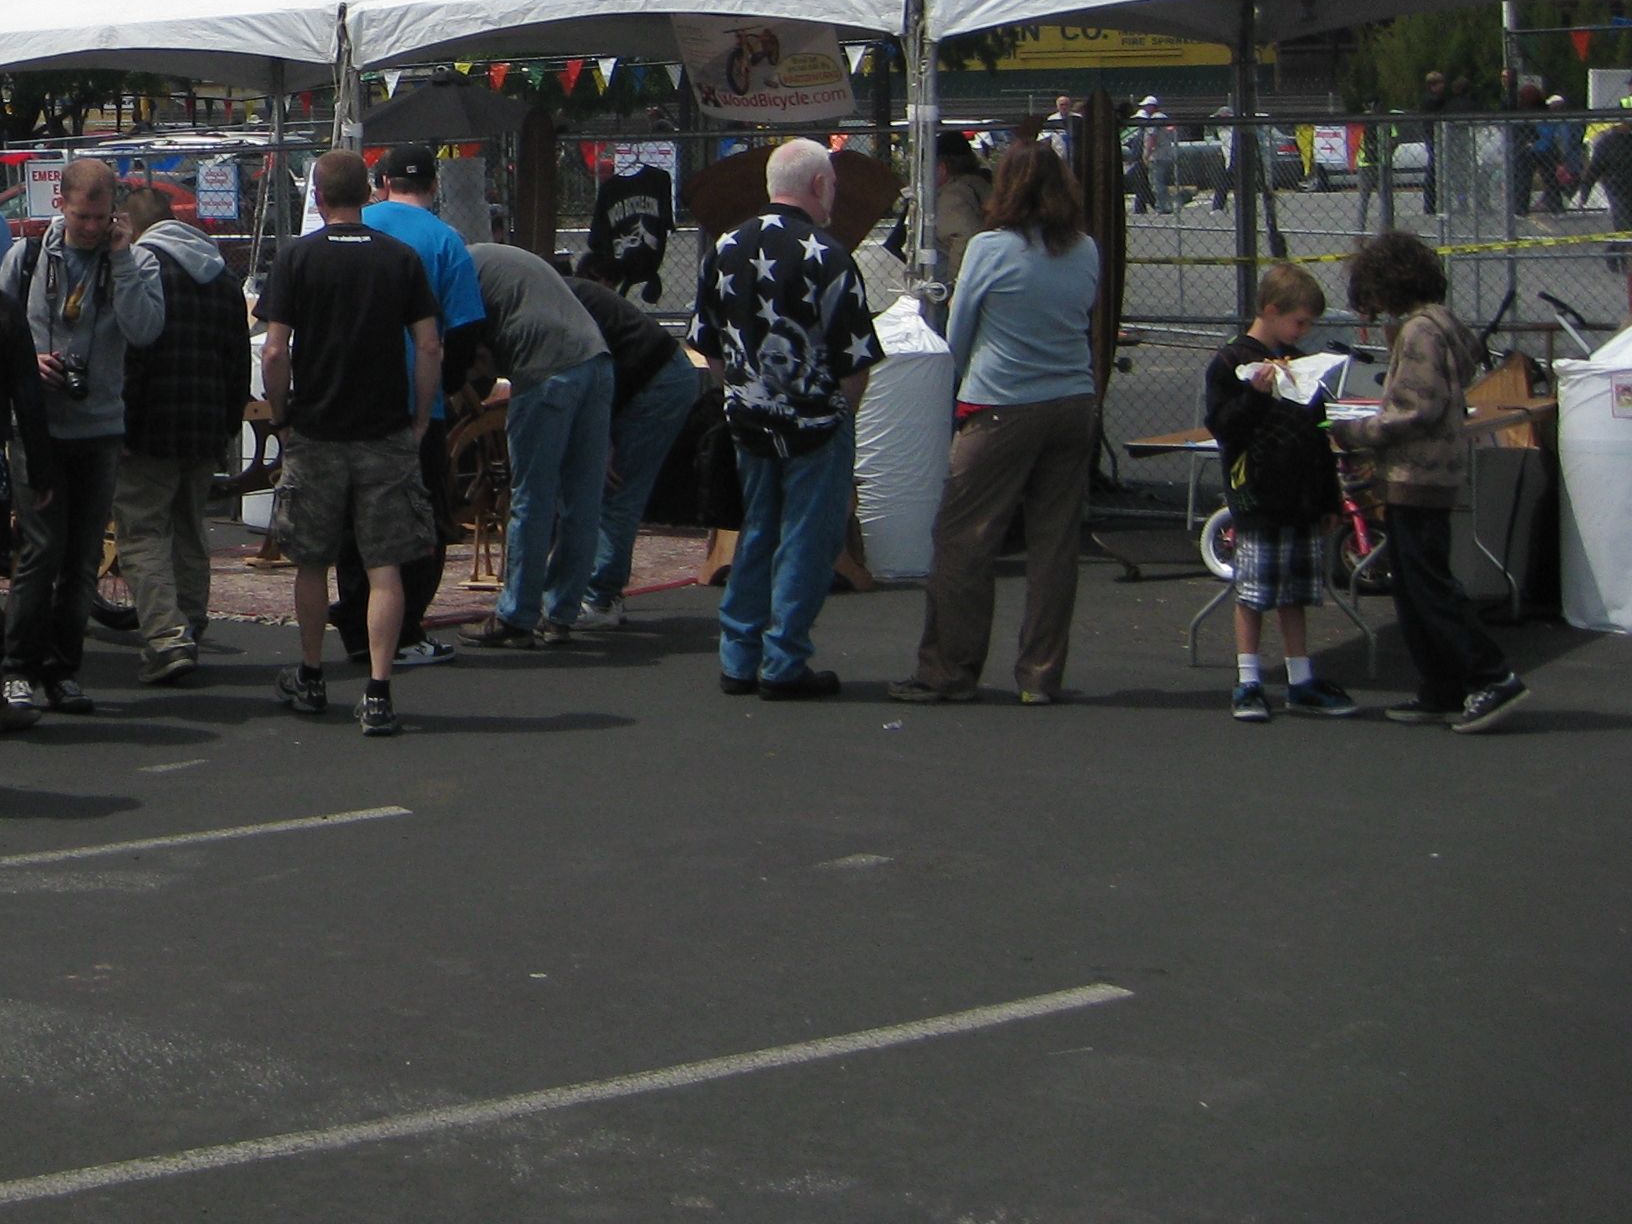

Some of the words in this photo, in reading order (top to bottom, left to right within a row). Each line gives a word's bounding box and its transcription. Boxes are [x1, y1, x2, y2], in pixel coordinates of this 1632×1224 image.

[1060, 26, 1108, 41] CO.
[719, 88, 847, 111] WoodBicycle.com
[32, 170, 61, 182] EMER
